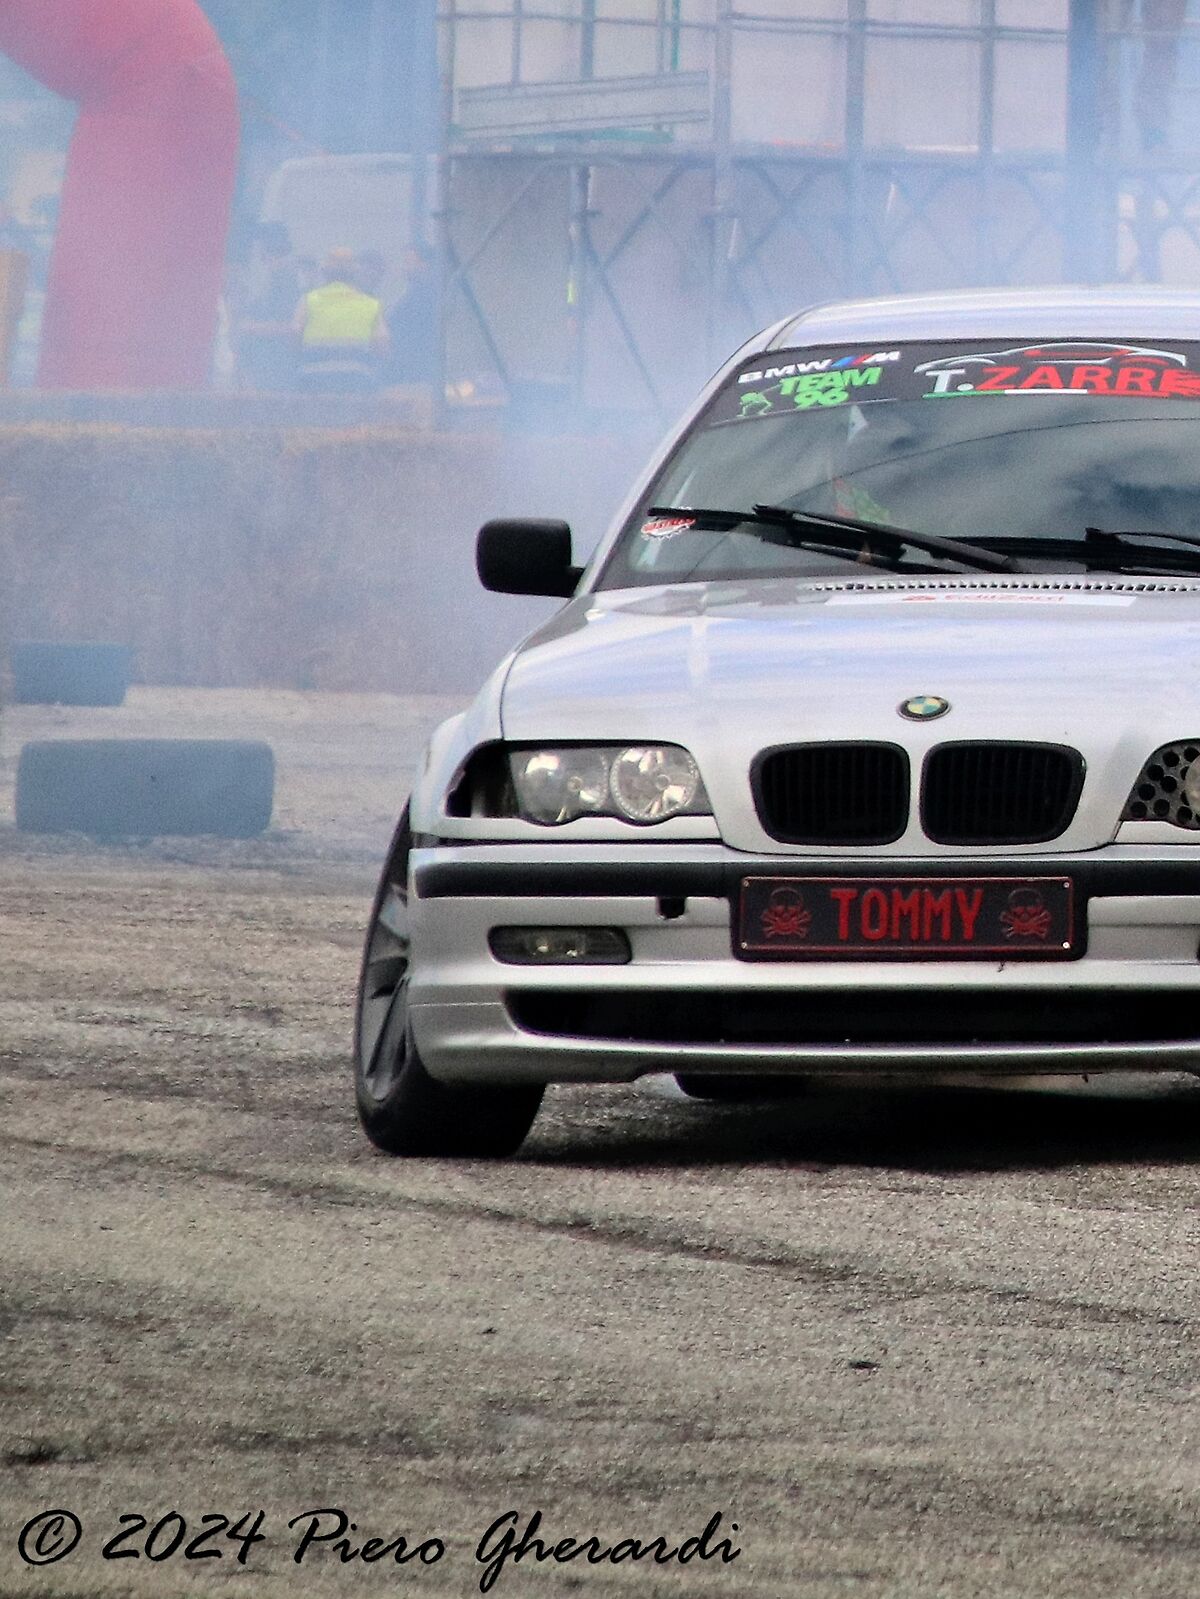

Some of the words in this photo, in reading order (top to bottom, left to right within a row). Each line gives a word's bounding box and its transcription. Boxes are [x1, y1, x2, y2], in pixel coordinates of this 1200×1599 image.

[738, 358, 833, 384] BMW
[780, 366, 883, 396] TEAM
[830, 888, 984, 941] TOMMY
